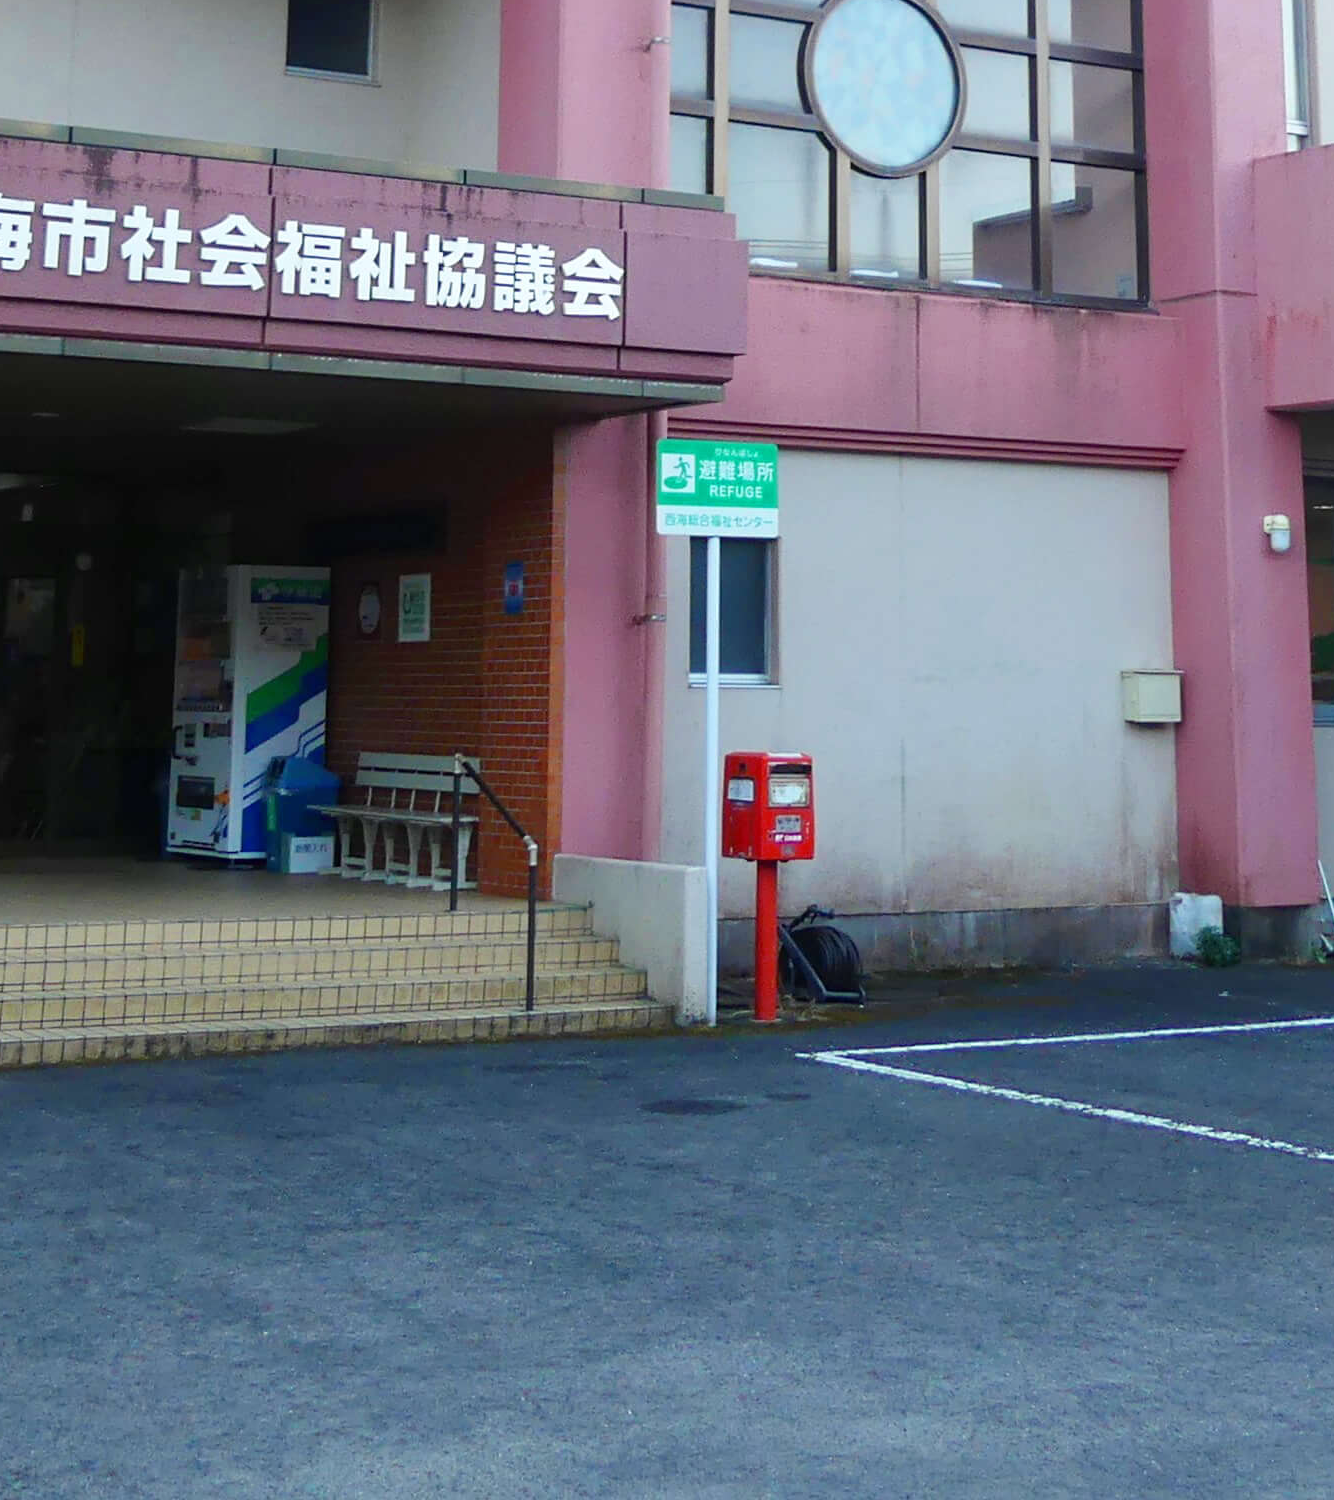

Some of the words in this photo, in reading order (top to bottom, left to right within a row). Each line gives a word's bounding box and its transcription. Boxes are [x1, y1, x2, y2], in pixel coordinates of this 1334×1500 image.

[699, 459, 774, 482] 避難場所
[709, 485, 763, 499] REFUGE
